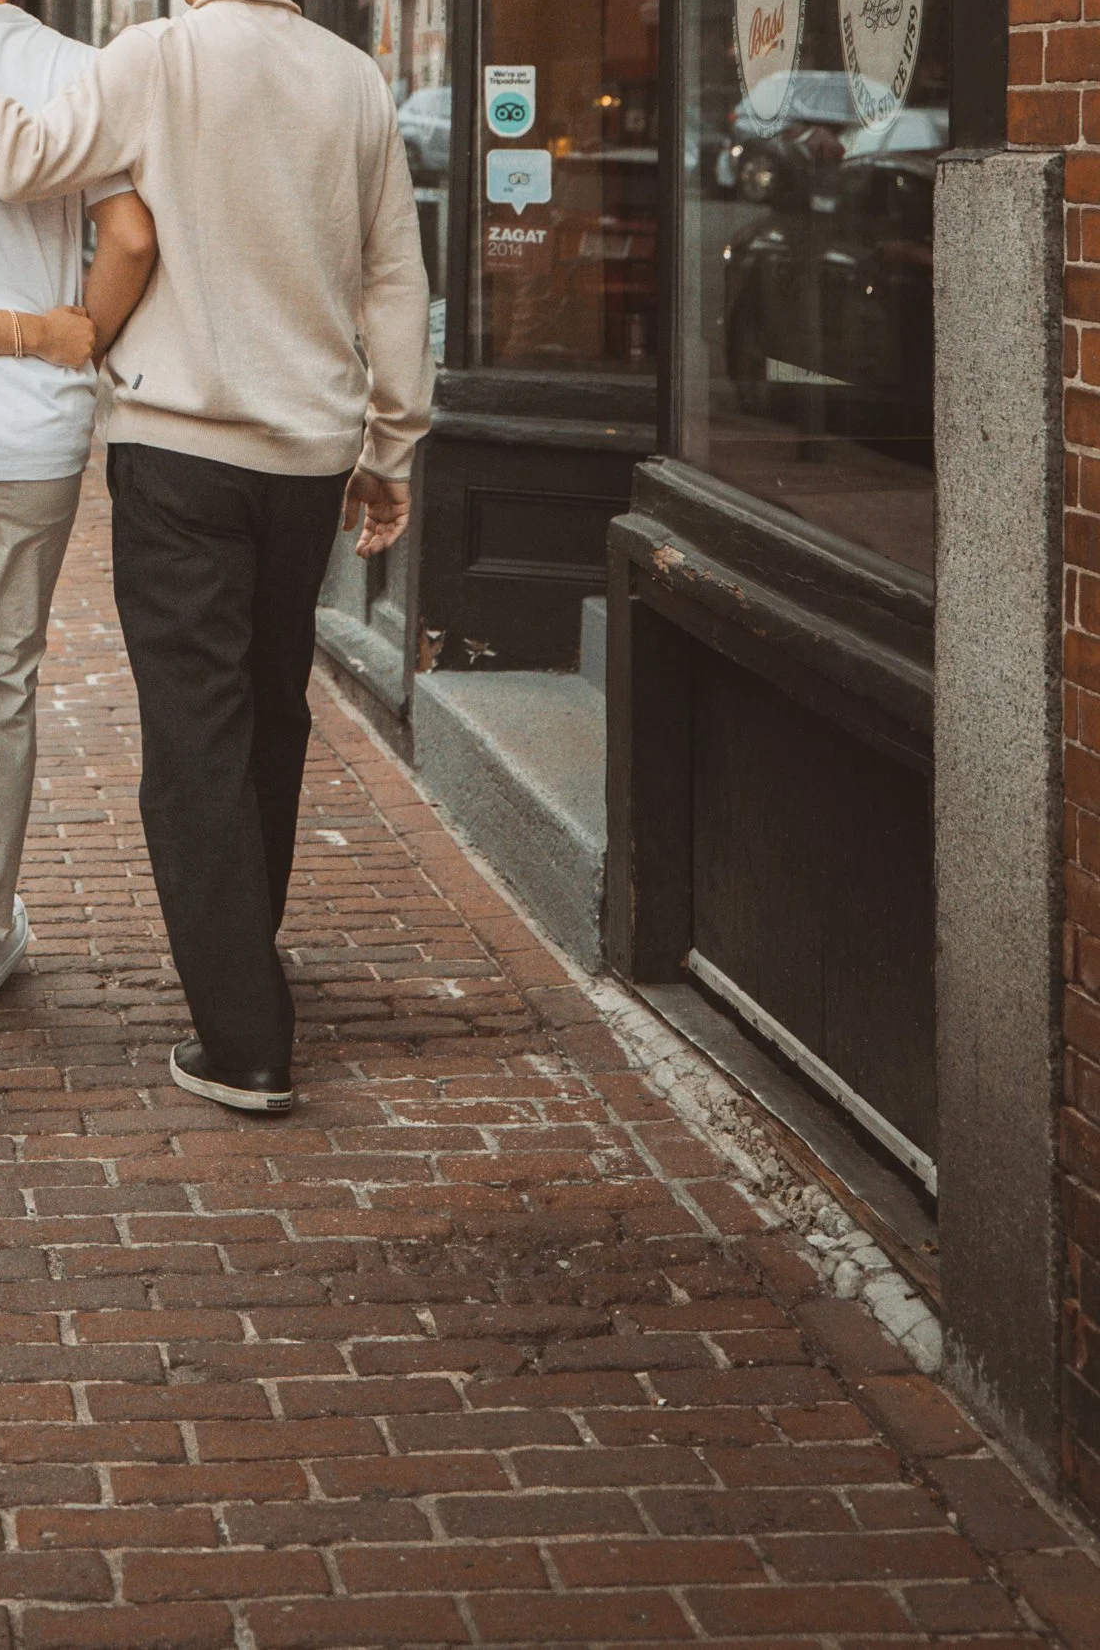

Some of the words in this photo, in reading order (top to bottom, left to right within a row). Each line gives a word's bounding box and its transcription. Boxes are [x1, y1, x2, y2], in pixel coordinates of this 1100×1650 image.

[748, 0, 785, 63] Bass
[902, 4, 919, 64] 1759
[488, 227, 548, 245] ZAGAT
[488, 241, 523, 258] 2014
